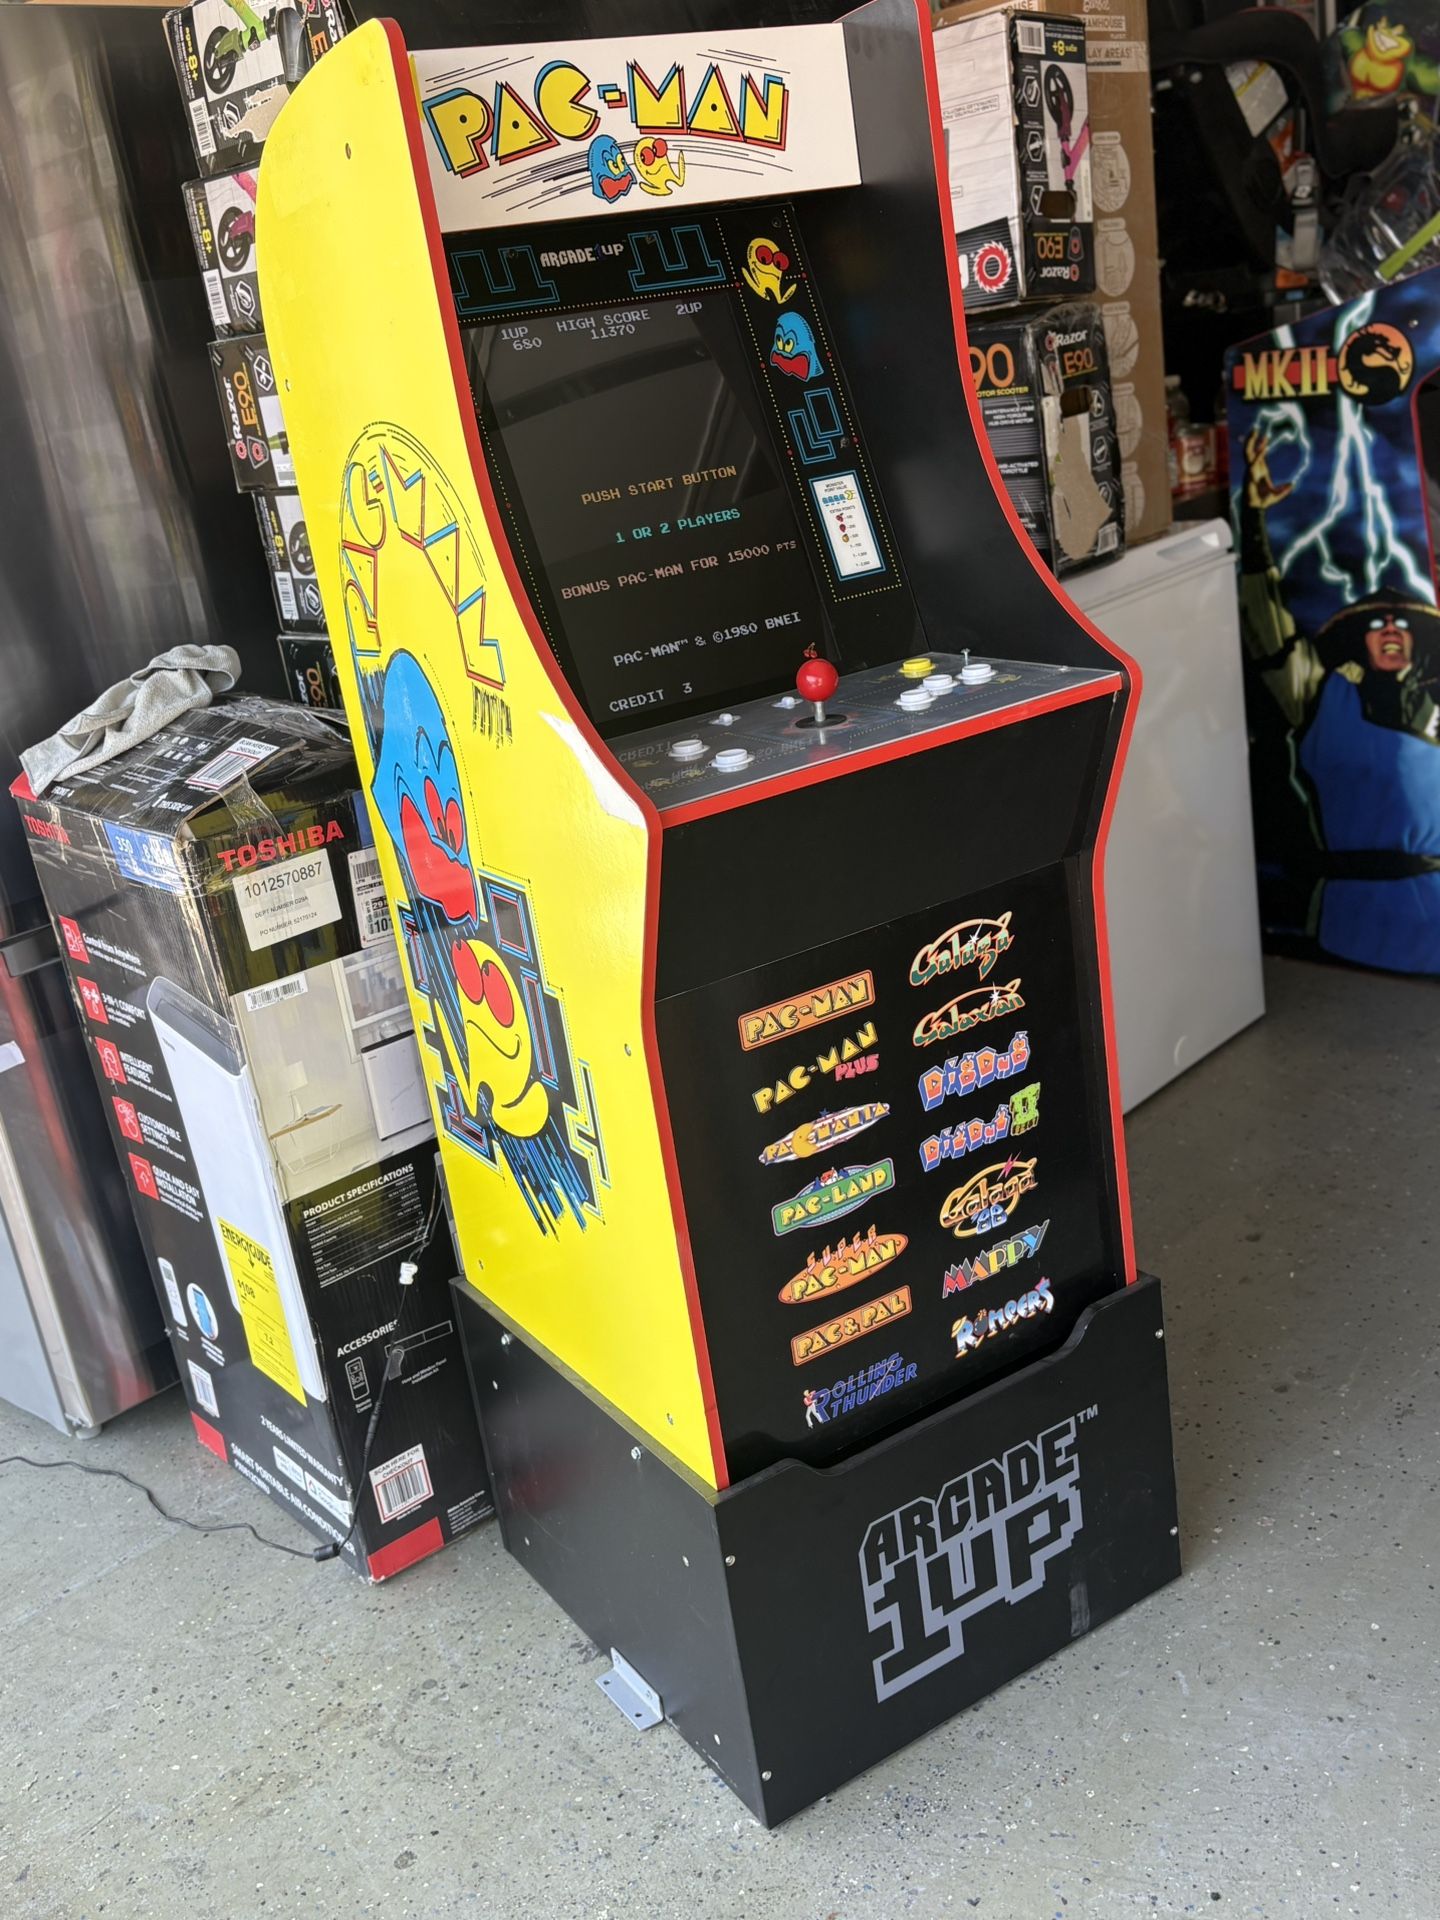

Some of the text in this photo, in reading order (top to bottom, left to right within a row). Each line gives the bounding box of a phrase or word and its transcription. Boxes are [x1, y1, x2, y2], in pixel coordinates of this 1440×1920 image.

[1088, 48, 1102, 59] LAY
[422, 59, 789, 178] PAC-MAN
[1037, 235, 1063, 259] E90
[556, 309, 651, 332] HIGH SCORE
[675, 301, 702, 316] 2UP
[500, 327, 529, 341] 1UP
[512, 337, 542, 351] 680
[590, 324, 635, 340] 11370
[1055, 330, 1088, 347] Razor
[968, 343, 1014, 388] 90
[1064, 348, 1093, 374] E90
[223, 376, 242, 439] Razor
[234, 371, 257, 426] E90
[977, 386, 1029, 398] OTOR SCOOTER
[581, 465, 737, 506] PUSH START BUTTON
[615, 508, 741, 544] 1 OR 2 PLAYERS
[342, 442, 506, 691] PAC-MAN
[561, 540, 797, 600] BONUS PAC-MAN FOR 15000 PTS
[695, 635, 706, 647] &
[765, 611, 801, 631] BNEI
[609, 682, 692, 712] CREDIT 3
[115, 836, 133, 854] 350
[217, 820, 344, 872] TOSHIBA
[245, 861, 322, 899] 1012570887
[255, 900, 294, 919] DEPT NUMBER
[269, 920, 293, 932] NUMBER
[910, 911, 1014, 987] Galaga
[744, 976, 869, 1044] PAC-MAN
[752, 1021, 879, 1114] PAC-MAN
[834, 1053, 880, 1082] PLUS
[303, 1194, 346, 1219] PRODUCT
[346, 1163, 414, 1201] SPECIFICATIONS
[780, 1166, 889, 1228] PAC-LAND
[807, 1222, 878, 1276] SUPER
[942, 1218, 1051, 1300] MAPPY
[791, 1239, 899, 1304] PAC-MAN
[796, 1295, 906, 1359] PAC & PAL
[810, 1352, 904, 1424] ROLLING
[830, 1362, 918, 1420] THUNDER
[306, 1452, 344, 1487] WARRANTY
[374, 1447, 420, 1476] SCAN HERE FOR
[382, 1457, 413, 1479] CHECKOUT
[230, 1442, 255, 1470] SMART
[254, 1461, 291, 1501] PORTABLE
[289, 1492, 304, 1512] AIR
[303, 1504, 357, 1556] CONDITIONR
[859, 1416, 1080, 1590] ARCADE
[870, 1487, 1083, 1704] 1UP
